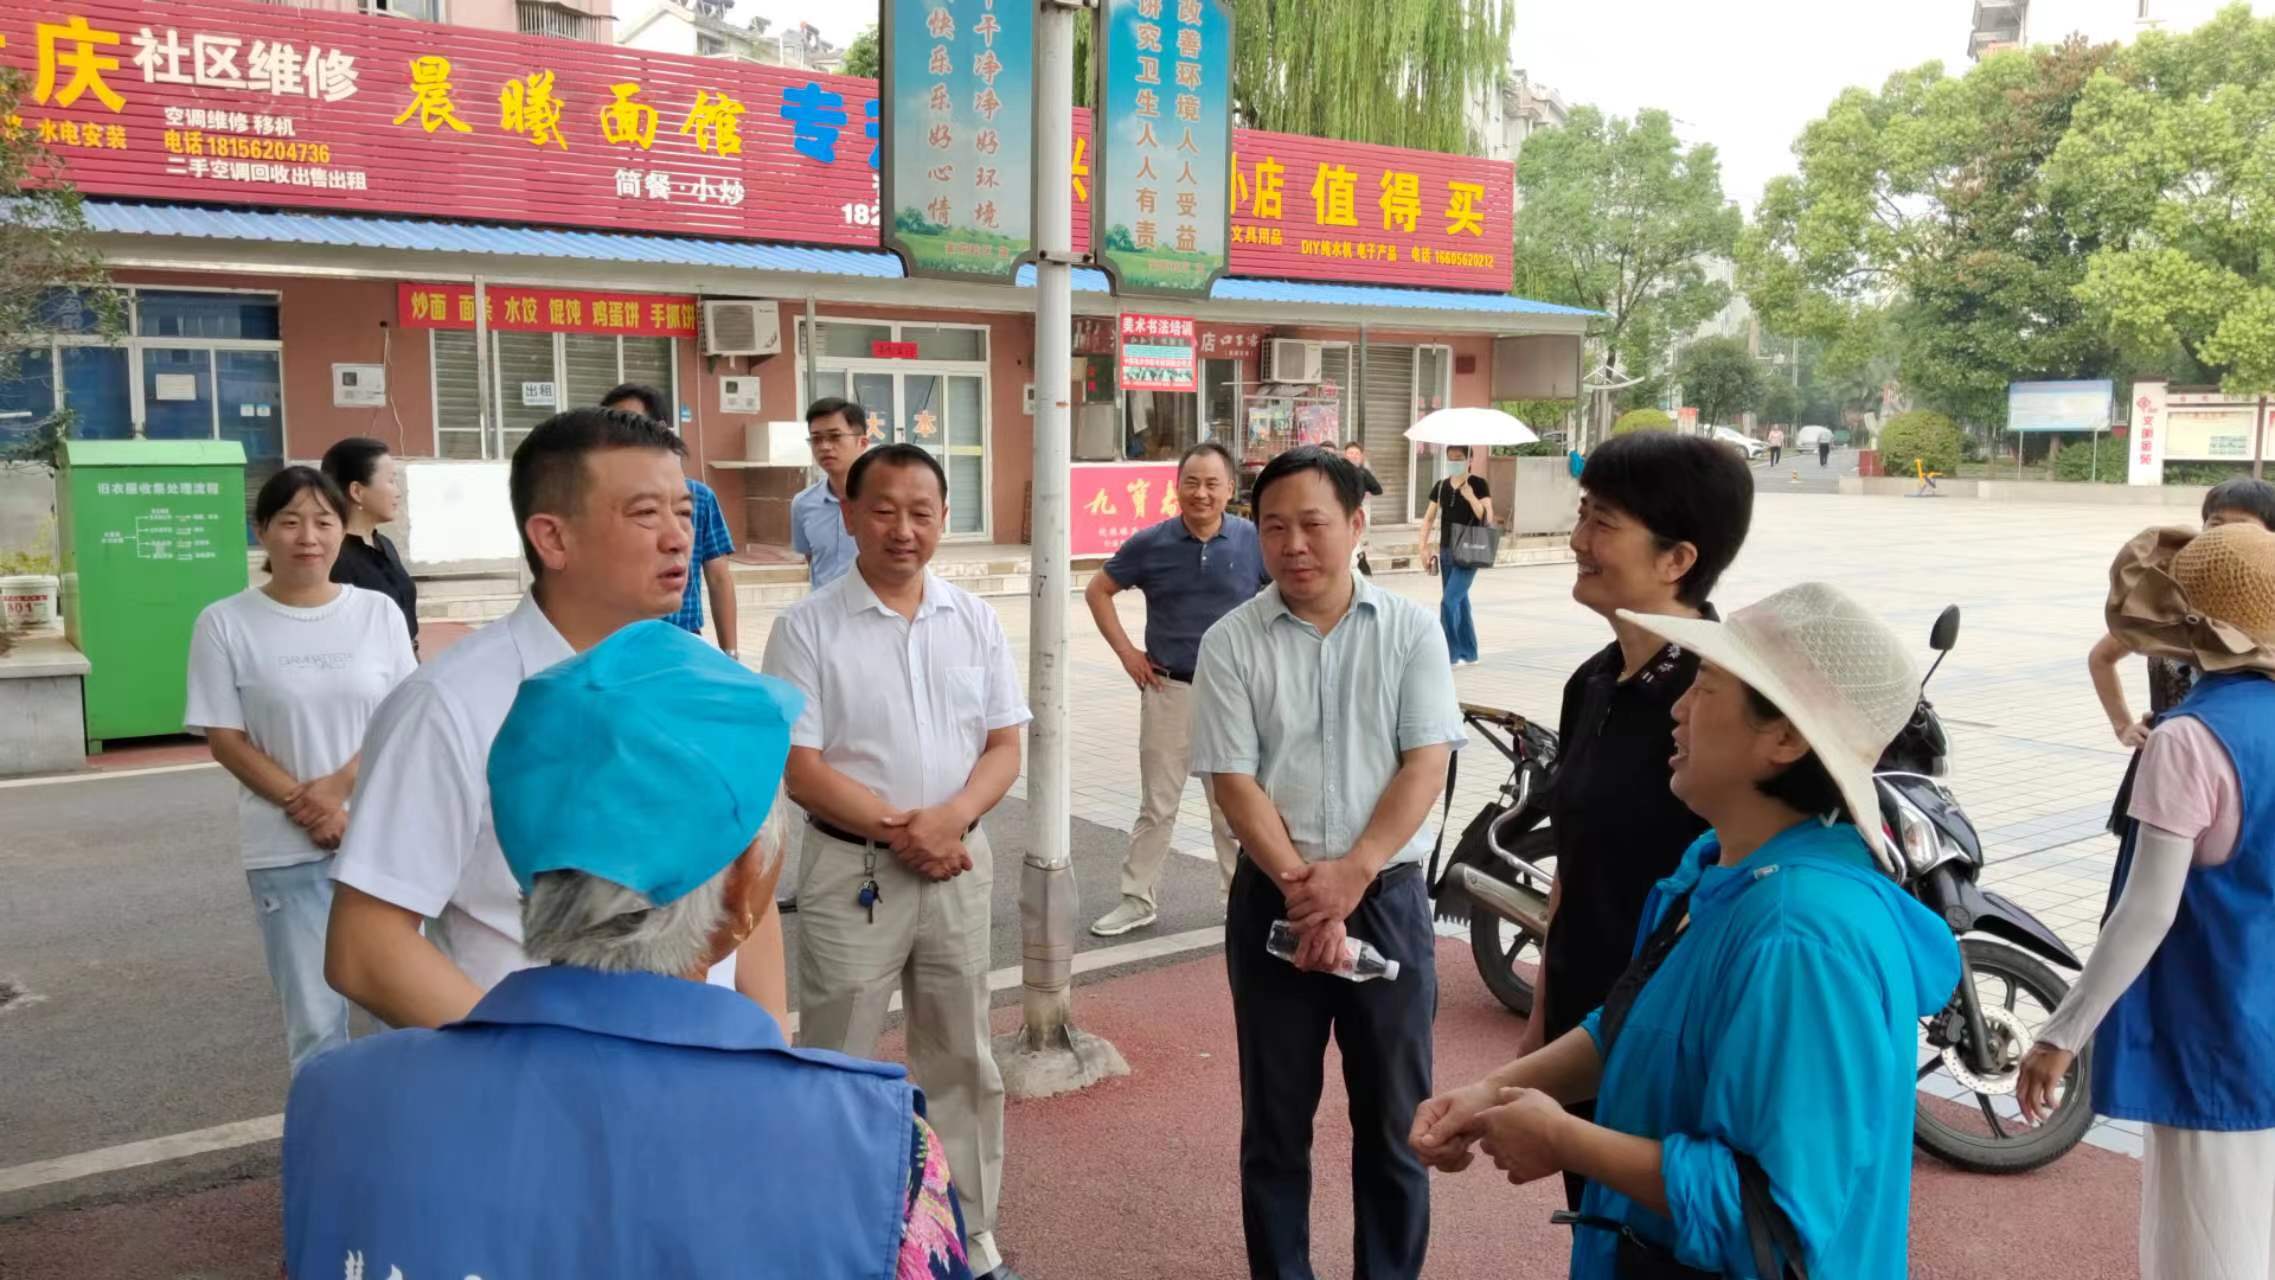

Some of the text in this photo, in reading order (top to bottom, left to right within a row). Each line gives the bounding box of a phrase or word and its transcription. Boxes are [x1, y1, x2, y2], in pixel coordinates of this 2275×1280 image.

[33, 15, 127, 113] 庆
[131, 27, 359, 102] 社区维修
[39, 118, 128, 149] 水电安装
[164, 107, 295, 136] 空调维修 移机
[393, 56, 747, 158] 晨曦面馆
[780, 81, 880, 171] 专
[973, 0, 1002, 229] 干净净好环境
[1176, 0, 1202, 252] 改善环境人人受益
[164, 129, 331, 163] 电话 18156204736
[166, 156, 367, 190] 二手空调回收出售出租
[1311, 162, 1485, 236] 值得买
[411, 291, 446, 321] 炒面
[505, 296, 538, 324] 水饺
[549, 297, 582, 326] 馄饨
[592, 300, 640, 329] 鸡蛋饼
[651, 303, 696, 331] 手抓饼
[1122, 316, 1193, 337] 美术书法培训
[525, 384, 552, 397] 出租
